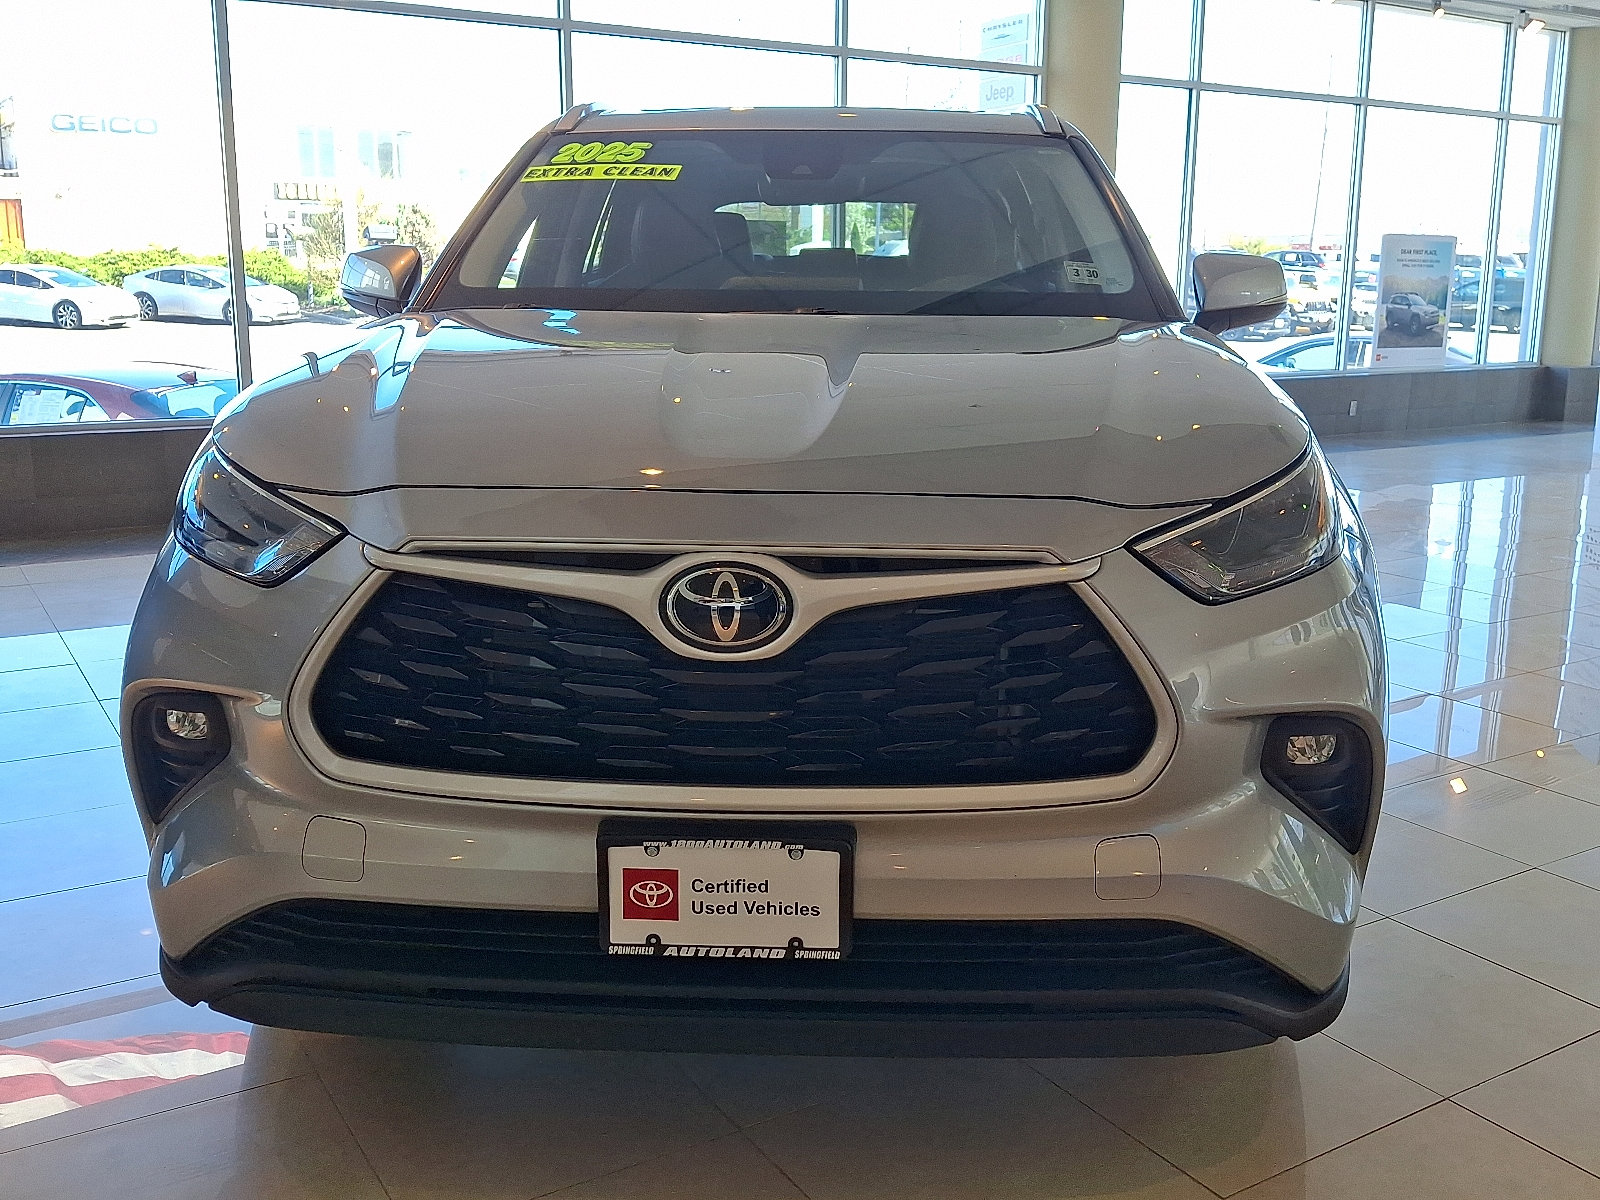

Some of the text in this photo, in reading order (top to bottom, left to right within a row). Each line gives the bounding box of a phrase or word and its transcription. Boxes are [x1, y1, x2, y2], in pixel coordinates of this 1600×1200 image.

[982, 19, 1023, 33] CHRYSLER
[985, 84, 1015, 102] Jeep
[51, 114, 158, 135] GEICO
[551, 141, 653, 164] 2025
[523, 166, 677, 179] EXTRA CLEAN
[1072, 268, 1099, 279] 3 30
[691, 878, 769, 894] Certified
[691, 901, 821, 917] Used Vehicles
[608, 945, 840, 960] SPRINGFIELD AUTOLAND SPRINGFIELD
